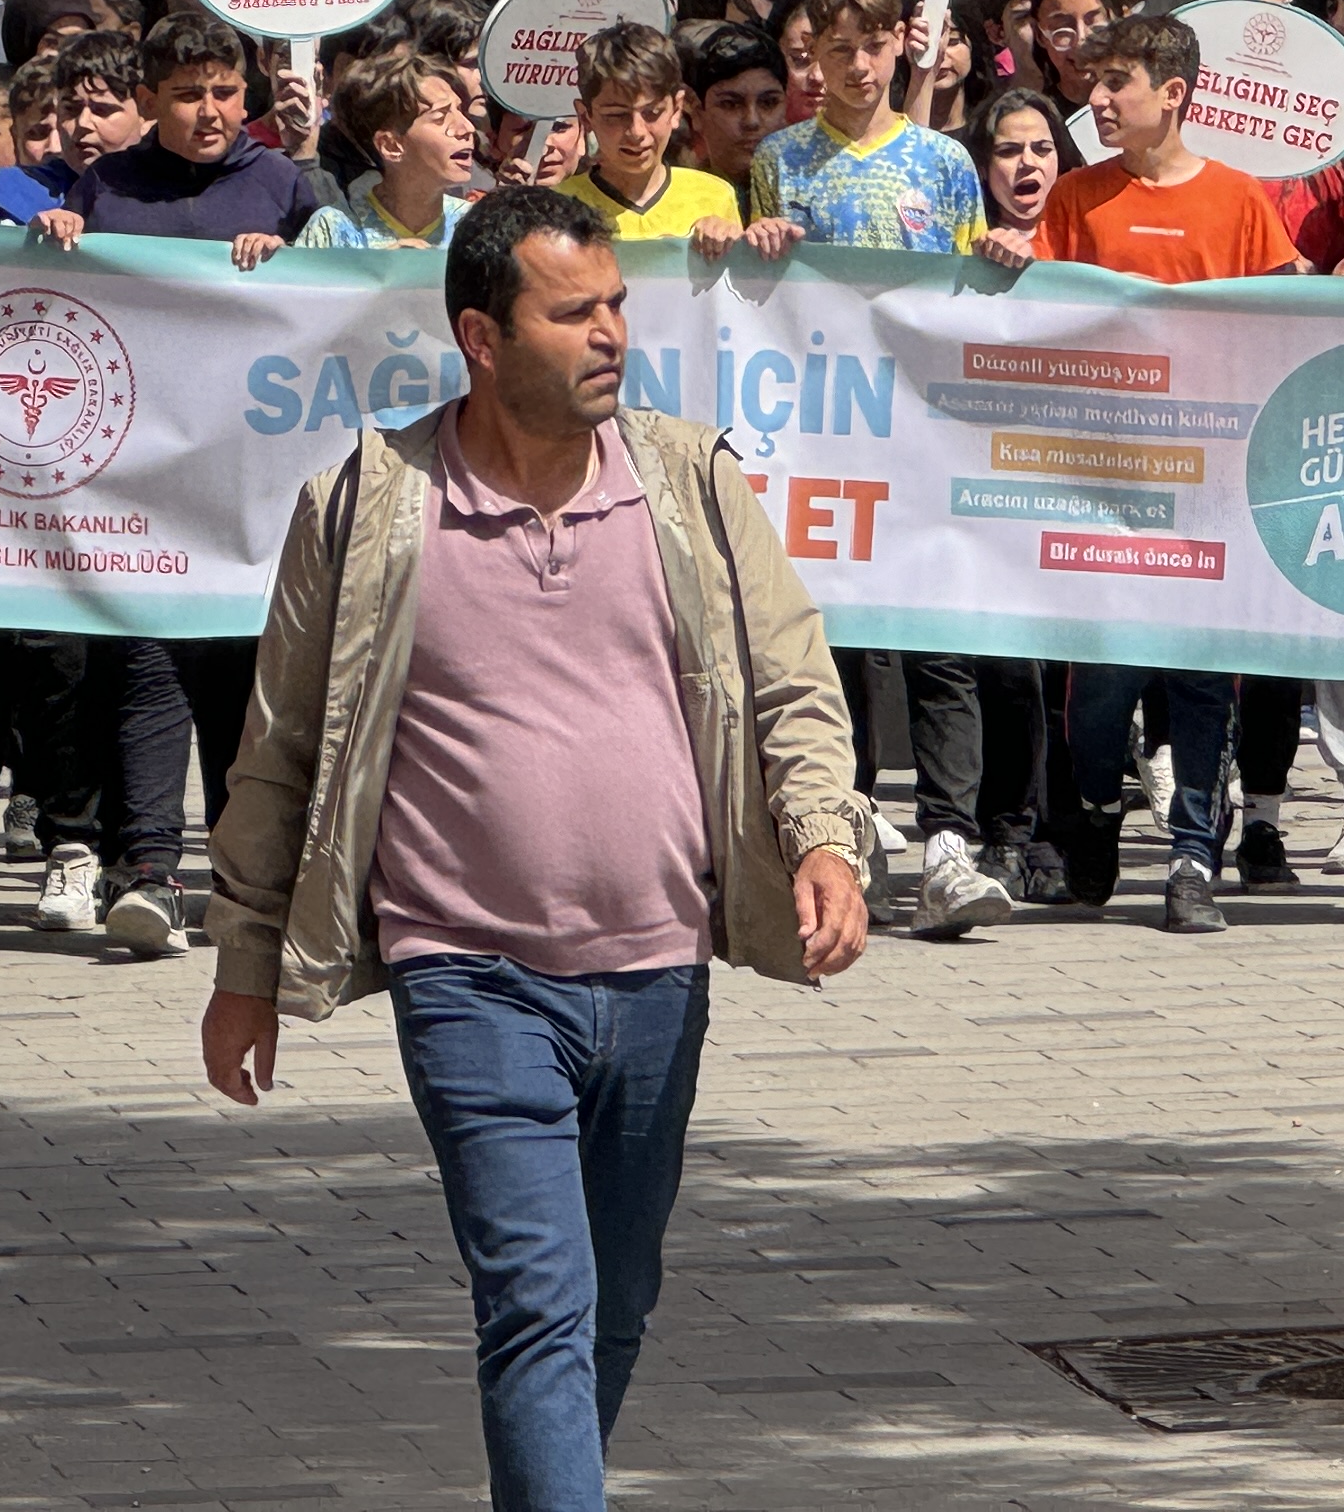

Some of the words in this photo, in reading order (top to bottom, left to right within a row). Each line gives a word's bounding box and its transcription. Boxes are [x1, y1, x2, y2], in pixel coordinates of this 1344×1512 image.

[503, 56, 579, 87] YÜRÜYO
[1195, 62, 1289, 113] ĞLIĞINI
[1293, 92, 1341, 127] SEÇ
[1186, 102, 1277, 141] REKETE
[1283, 124, 1334, 159] GEÇ
[1127, 364, 1162, 385] yap
[716, 326, 896, 458] İÇİN
[1153, 454, 1195, 475] yürü
[34, 512, 148, 536] BAKANLIĞI
[45, 548, 189, 575] MÜDÜRLÜĞÜ
[1050, 541, 1078, 562] Bir
[1083, 544, 1139, 566] durak
[1144, 547, 1193, 569] önce
[1198, 550, 1215, 569] in
